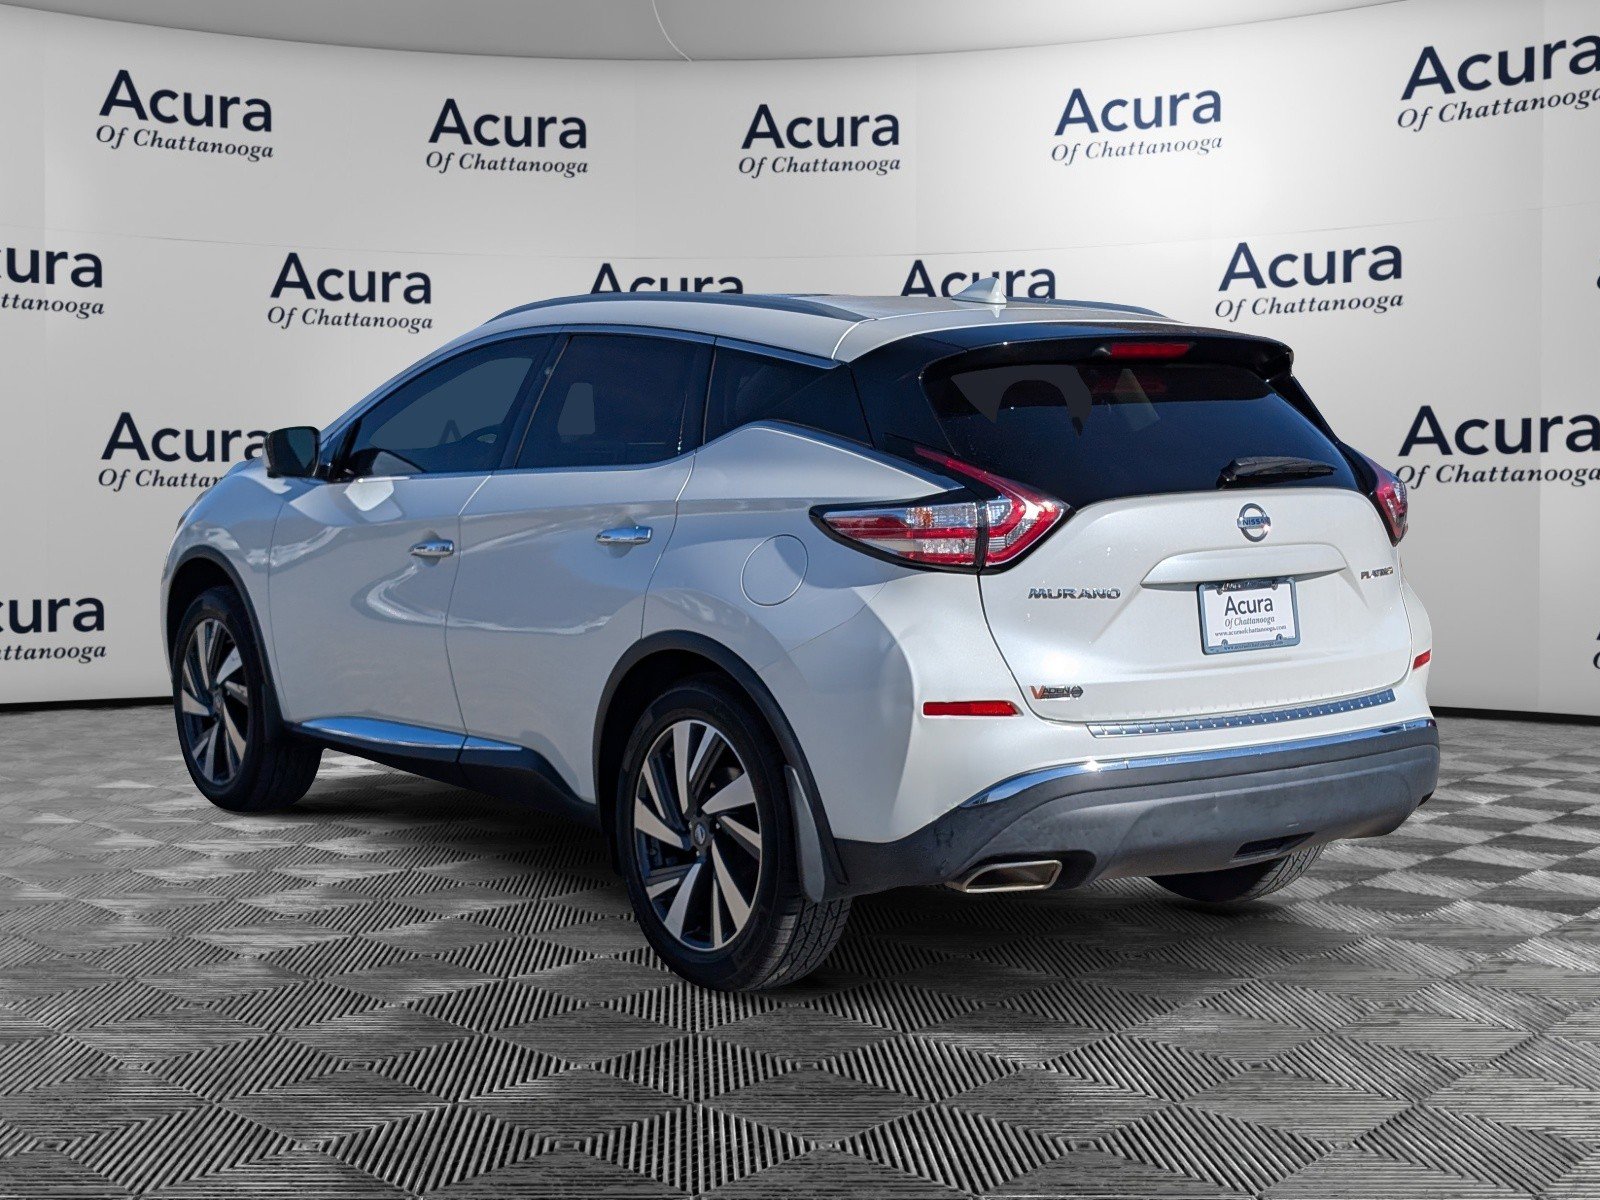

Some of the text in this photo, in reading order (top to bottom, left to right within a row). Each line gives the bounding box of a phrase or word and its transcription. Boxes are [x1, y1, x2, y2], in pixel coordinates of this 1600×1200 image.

[1400, 35, 1600, 101] Acura
[99, 69, 273, 132] Acura
[1054, 88, 1222, 136] Acura
[1397, 88, 1600, 133] Of Chattanooga
[428, 98, 587, 149] Acura
[741, 104, 899, 149] Acura
[96, 125, 274, 162] Of Chattanooga
[1051, 138, 1223, 166] Of Chattanooga
[426, 151, 588, 178] Of Chattanooga
[739, 156, 900, 179] Of Chattanooga
[0, 247, 102, 288] ura
[270, 252, 431, 305] Acura
[900, 260, 1056, 299] Acra
[1218, 242, 1402, 291] Acura
[267, 306, 433, 334] Of Chattanooga
[1215, 295, 1404, 322] Of Chattanooga
[101, 412, 266, 463] Acura
[1398, 405, 1600, 457] Acura
[98, 468, 131, 492] Of
[1396, 464, 1600, 490] Of Chattanooga
[1028, 588, 1121, 599] MURANO
[1224, 595, 1274, 616] Acura
[0, 597, 104, 634] ura
[1224, 616, 1275, 629] Of Chattanooga
[0, 645, 106, 664] ttanooga
